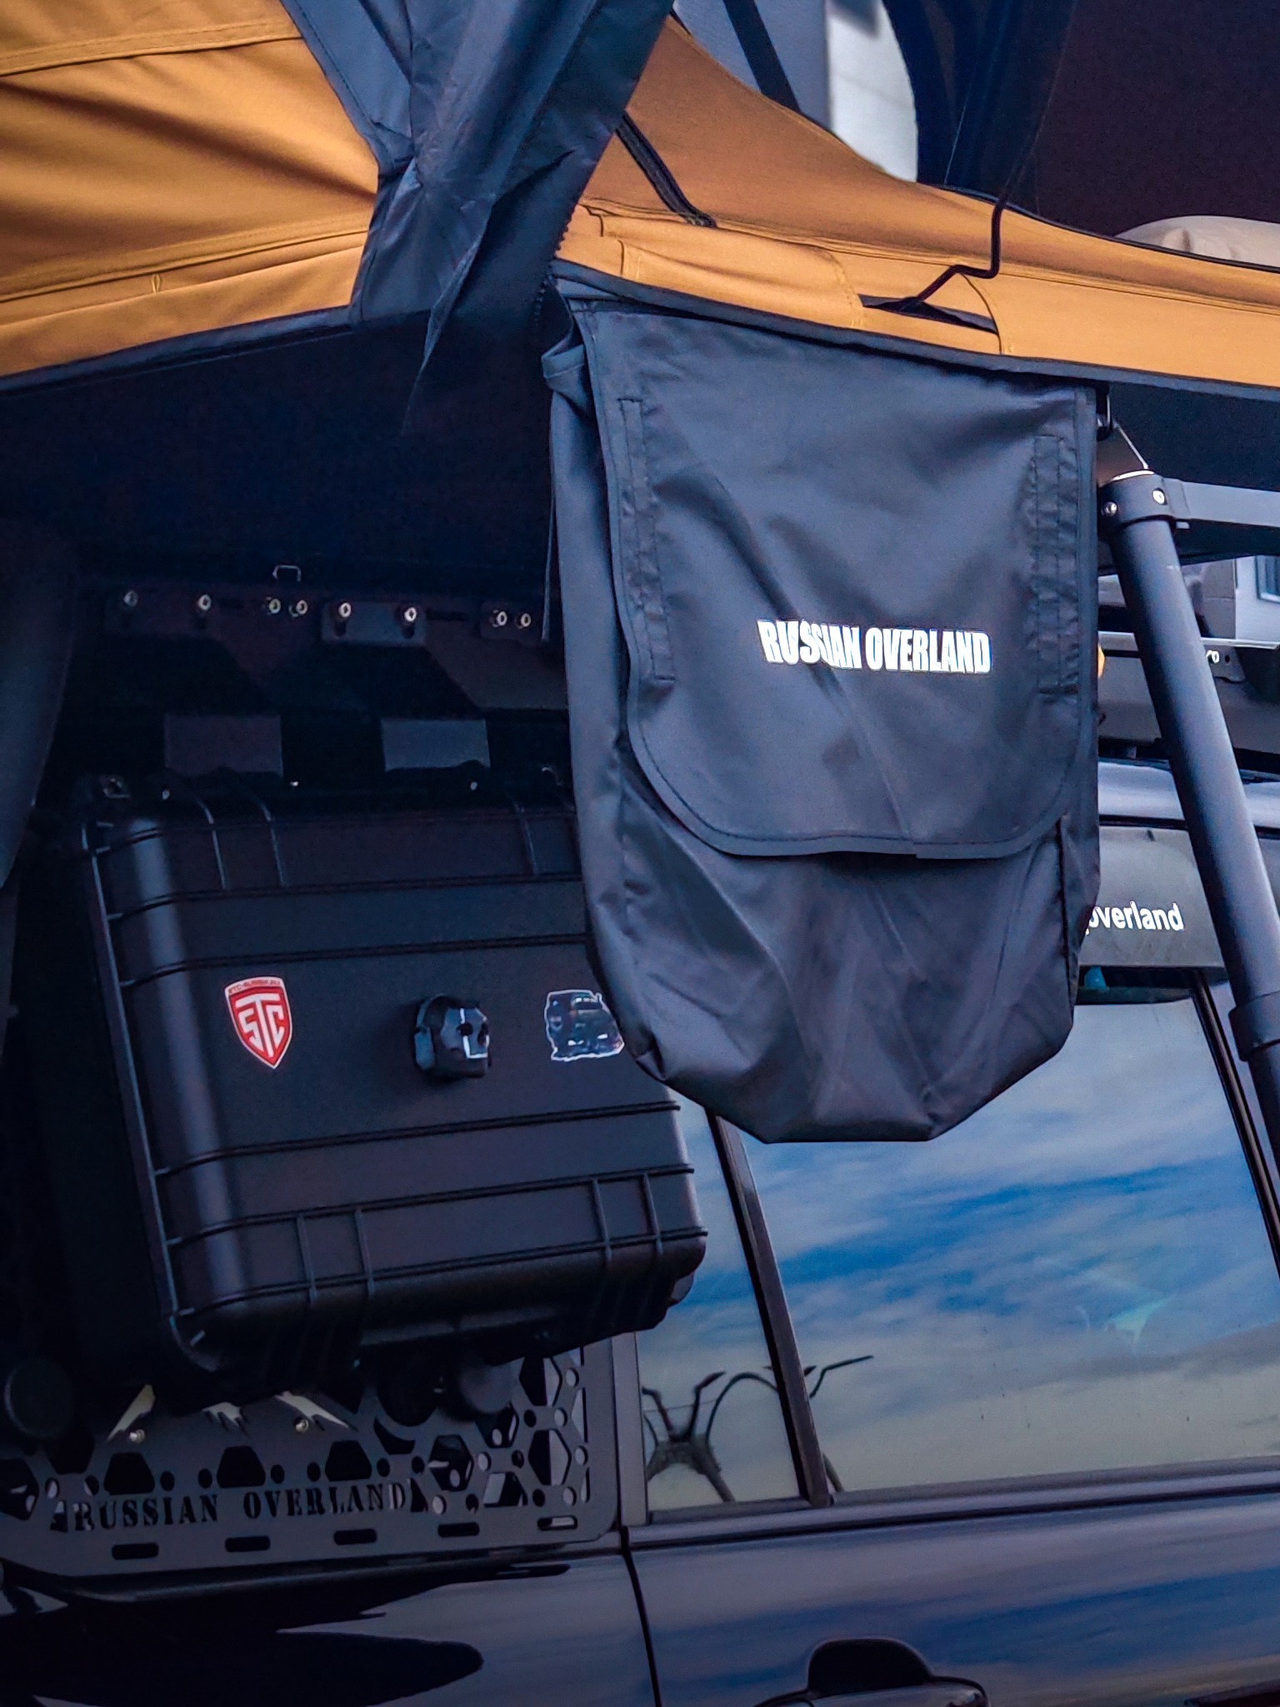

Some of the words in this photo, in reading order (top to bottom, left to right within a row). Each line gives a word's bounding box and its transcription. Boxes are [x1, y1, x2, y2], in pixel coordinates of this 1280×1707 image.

[757, 619, 862, 669] RUSSIAN
[865, 627, 992, 674] OVERLAND
[1085, 901, 1185, 935] overland
[74, 1496, 219, 1532] RUSSIAN
[243, 1482, 406, 1520] OVERLAND
